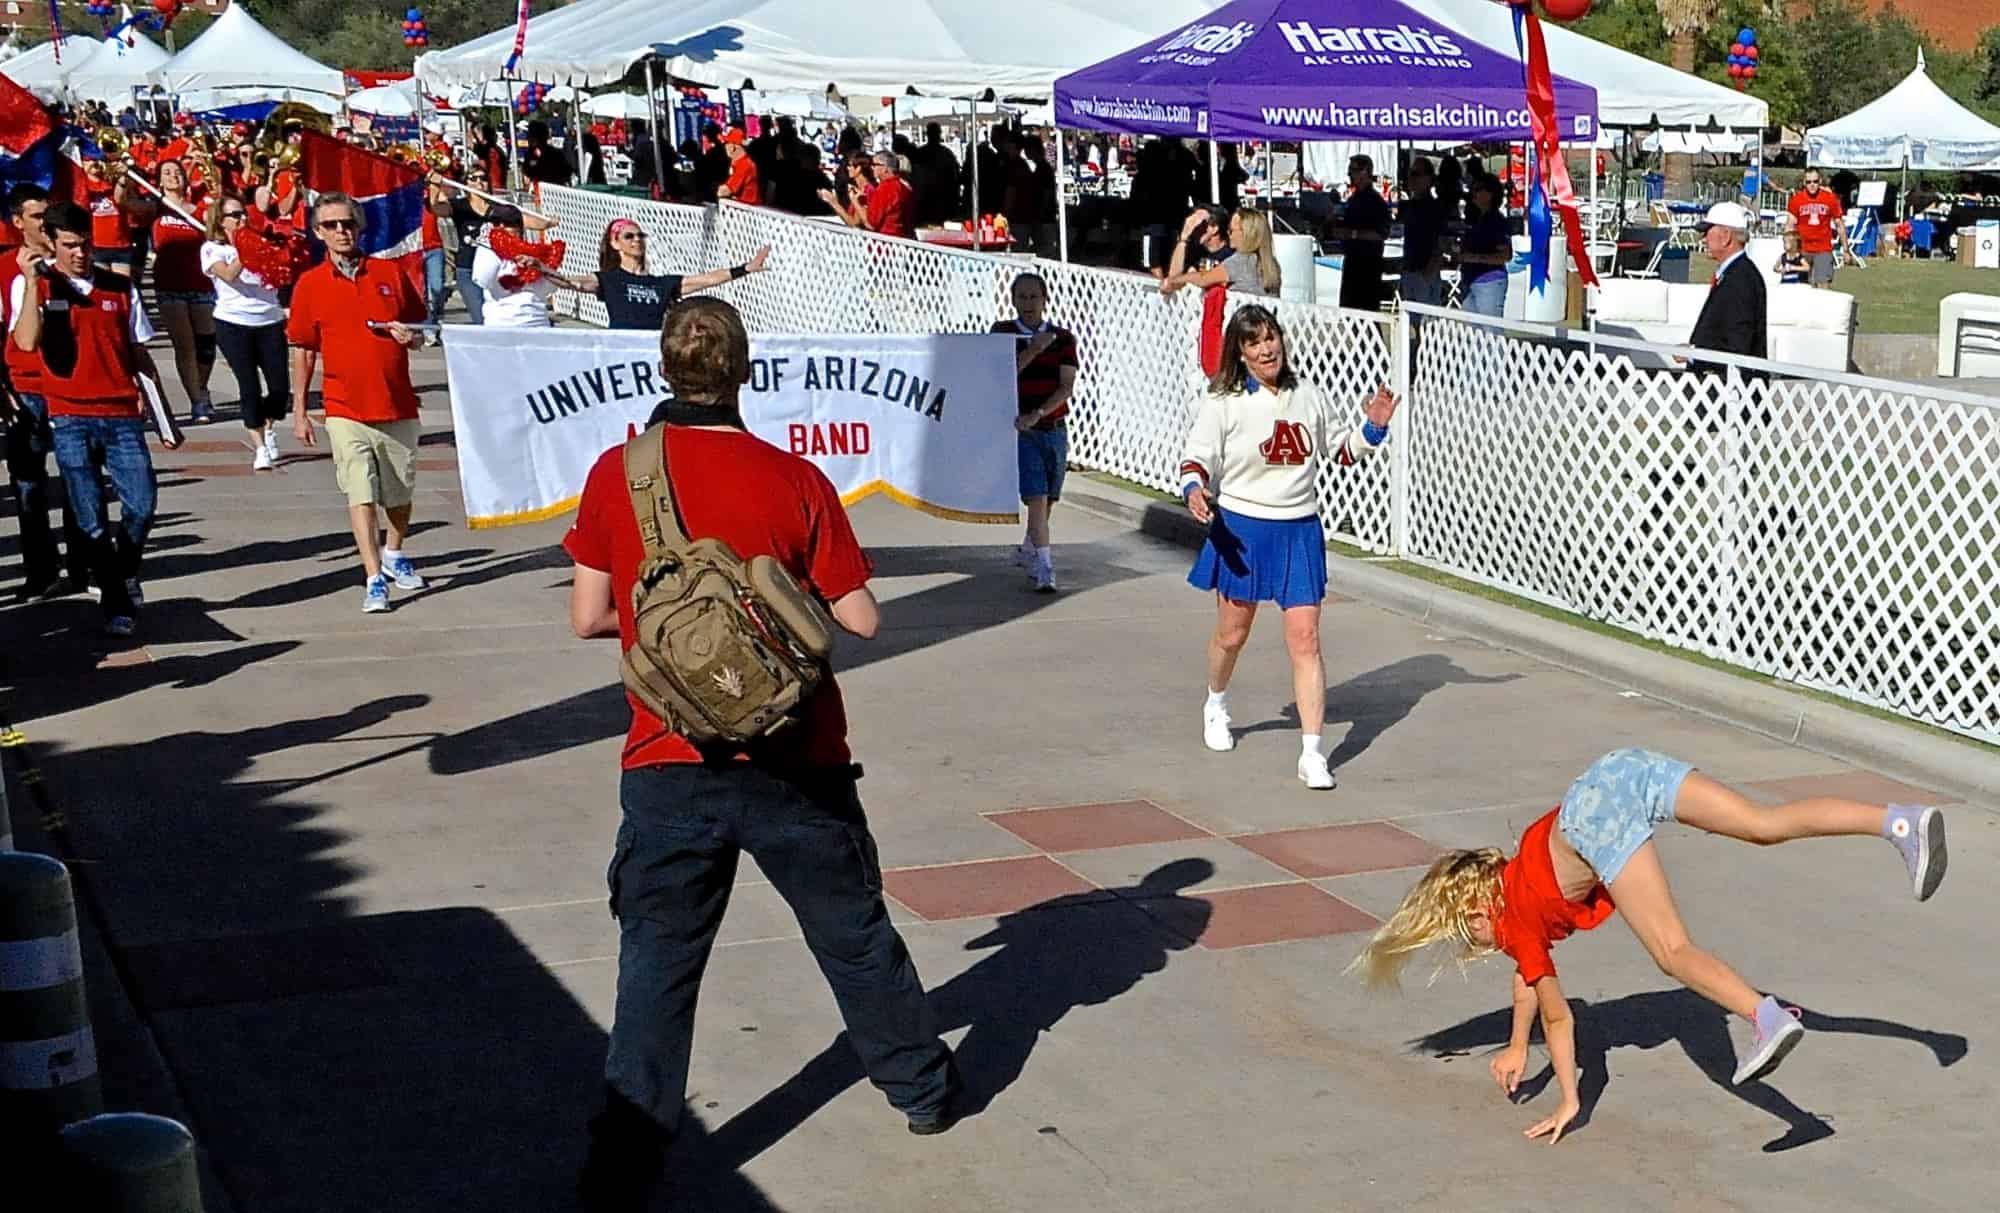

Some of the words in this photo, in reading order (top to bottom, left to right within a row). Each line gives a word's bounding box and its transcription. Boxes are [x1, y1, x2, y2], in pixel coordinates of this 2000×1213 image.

[1277, 21, 1462, 56] Harrah's
[1303, 54, 1393, 66] AK-CHIN
[1399, 55, 1473, 69] CASINO
[1070, 96, 1190, 123] www.harrahsakchin.com
[1262, 103, 1532, 129] www.harrahsakchin.co
[751, 358, 790, 392] OF
[804, 356, 948, 423] ARIZONA
[789, 421, 870, 456] BAND
